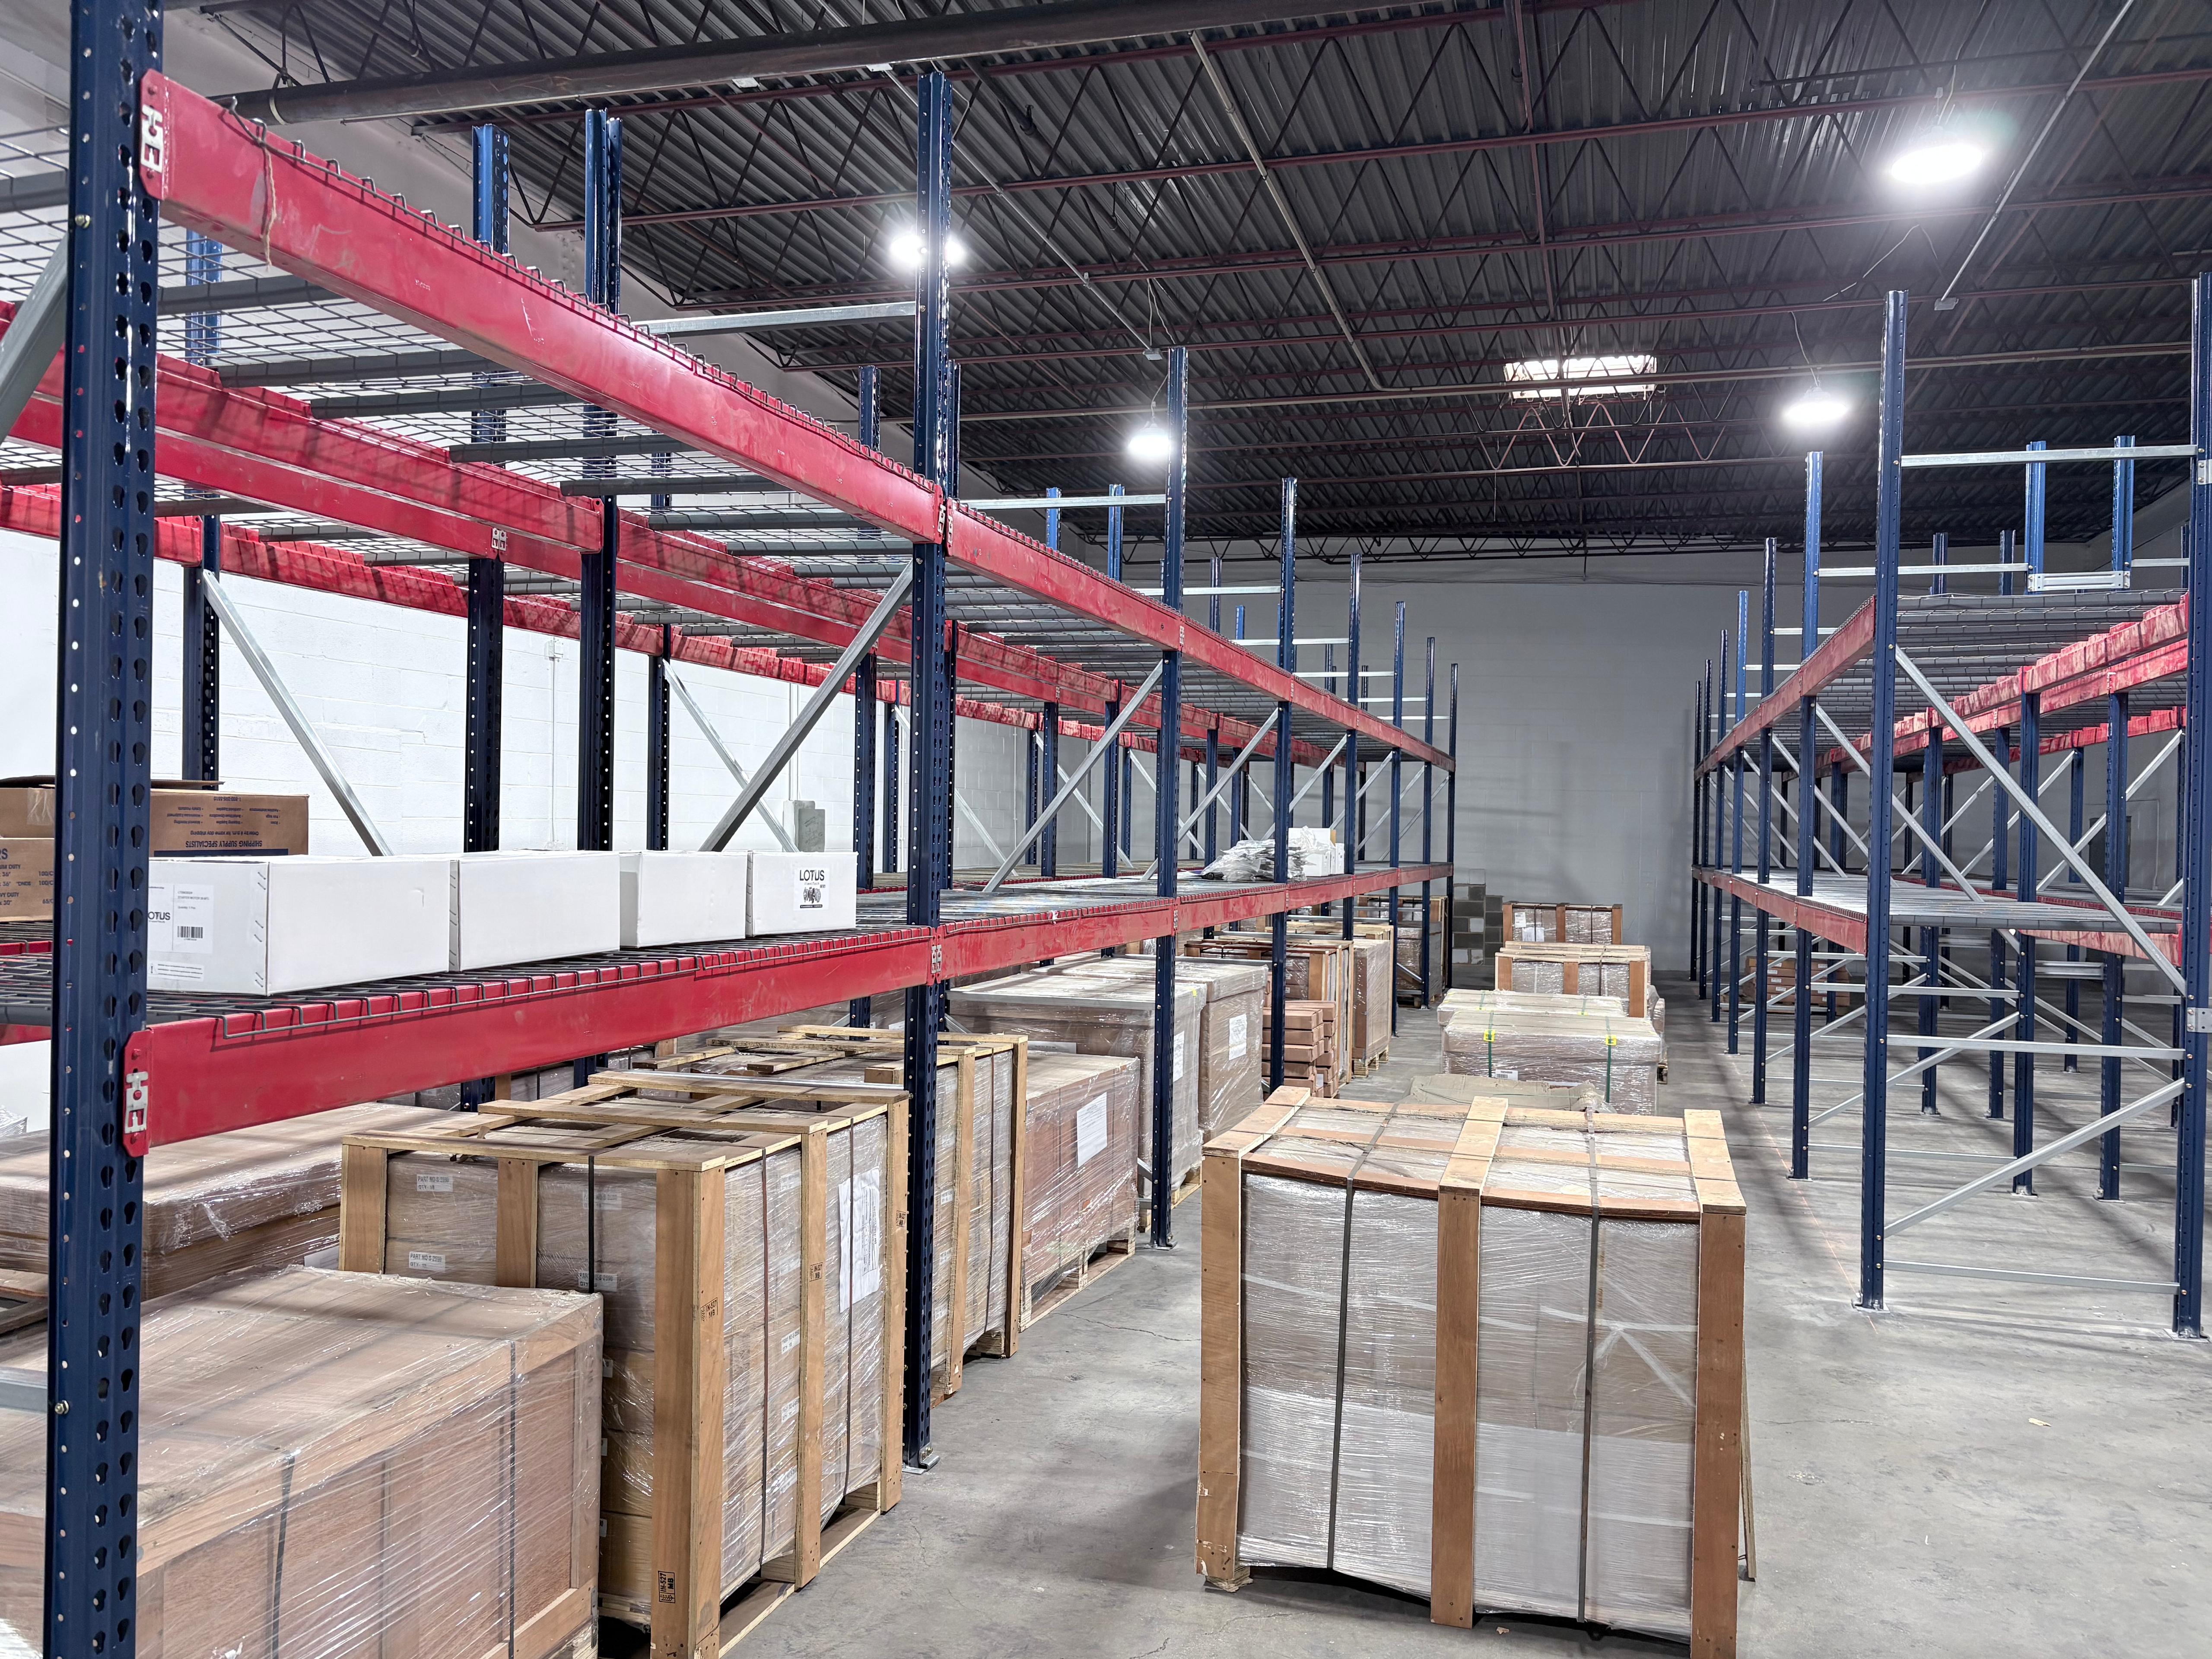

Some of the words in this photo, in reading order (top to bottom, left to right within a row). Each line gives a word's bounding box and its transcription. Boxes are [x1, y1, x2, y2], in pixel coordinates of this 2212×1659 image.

[800, 869, 824, 881] LOTUS
[148, 911, 171, 920] OTUS
[667, 1578, 674, 1589] MB
